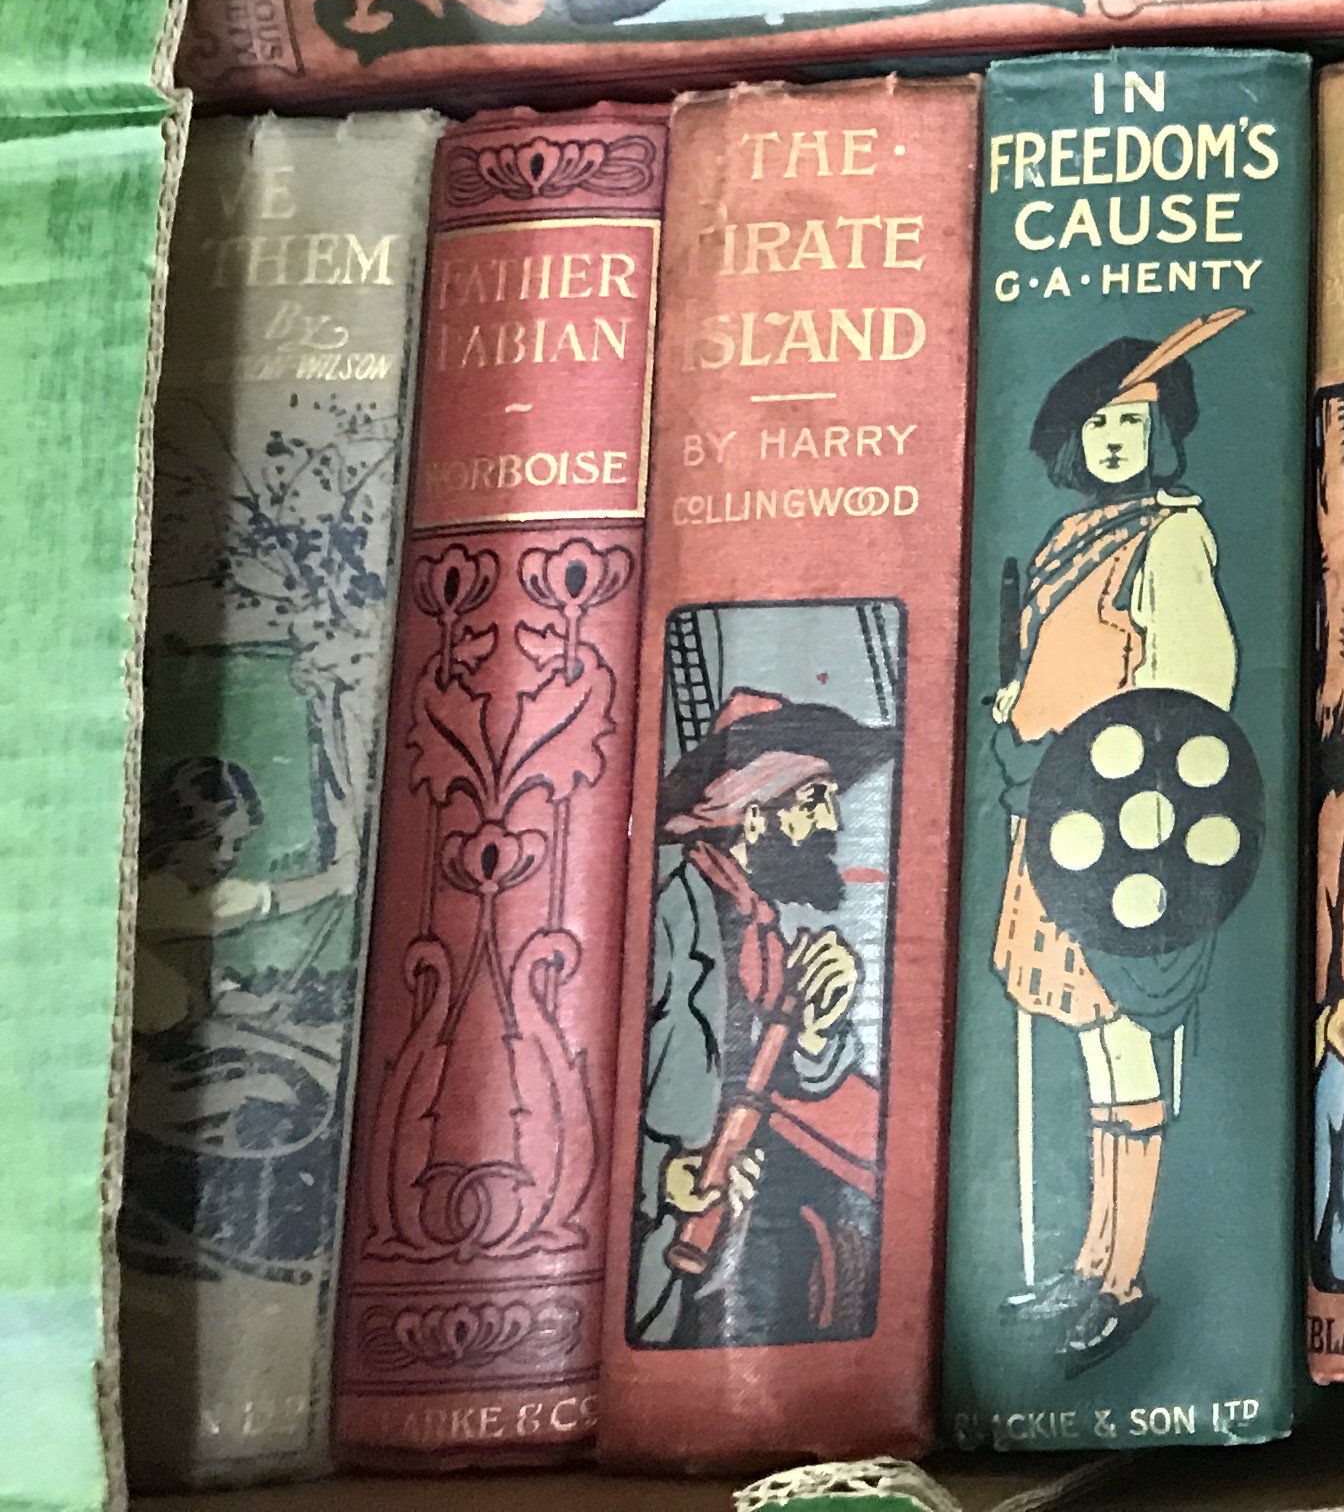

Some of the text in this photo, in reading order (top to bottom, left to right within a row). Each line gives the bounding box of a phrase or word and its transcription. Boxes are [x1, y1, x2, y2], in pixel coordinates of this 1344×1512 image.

[1093, 70, 1166, 115] IN
[988, 116, 1280, 194] FREEDOM'S
[688, 204, 926, 279] PIRATE
[1013, 192, 1243, 252] CAUSE
[437, 251, 639, 312] FATHER
[435, 316, 630, 373] FABIAN
[680, 298, 928, 373] ISLAND
[295, 352, 397, 382] WILSON
[682, 424, 918, 467] BY HARRY
[672, 485, 920, 527] COLLINGWOOD
[1092, 1407, 1118, 1439] &
[1129, 1404, 1196, 1438] SON
